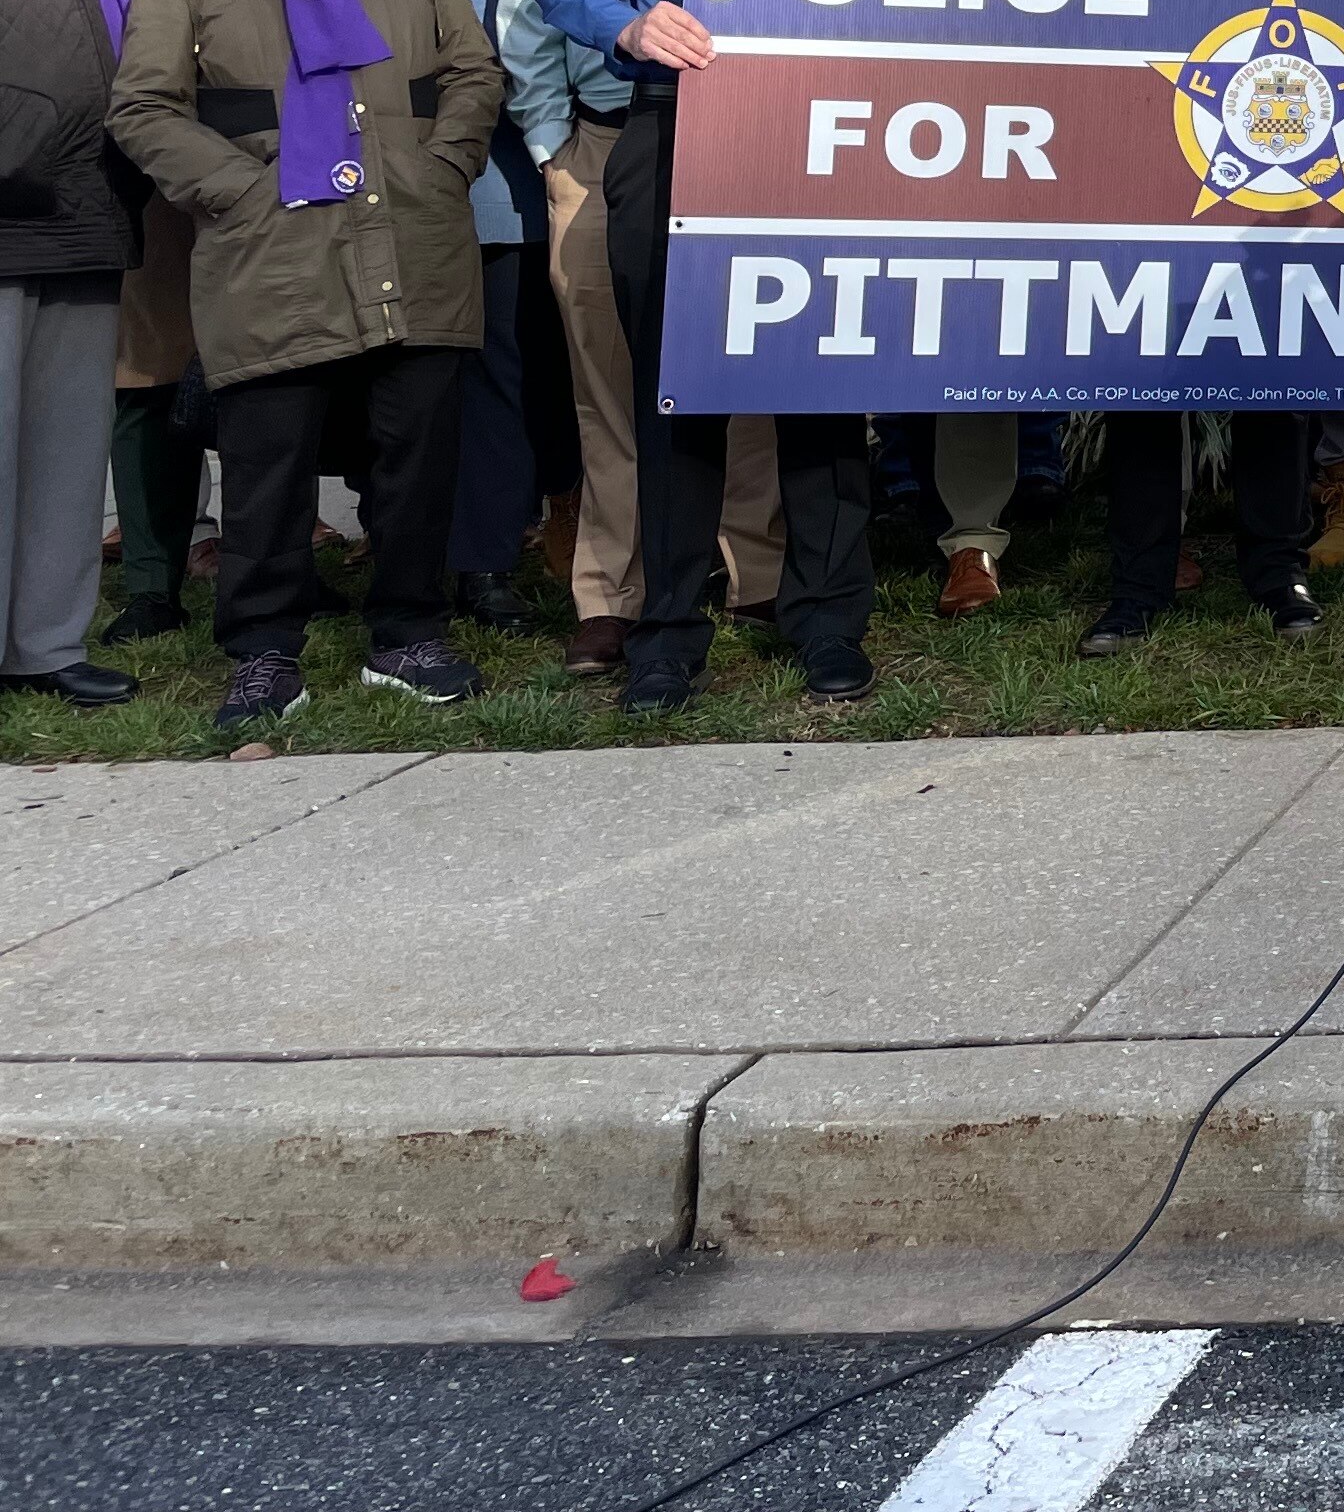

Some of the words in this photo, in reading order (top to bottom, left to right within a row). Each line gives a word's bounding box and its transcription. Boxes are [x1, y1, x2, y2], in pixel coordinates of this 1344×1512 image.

[806, 99, 1057, 181] FOR
[944, 387, 977, 400] Paid
[981, 387, 1002, 400] for
[1007, 387, 1026, 402] by
[1030, 387, 1062, 400] A.A.
[1066, 387, 1091, 400] Co.
[1095, 388, 1128, 400] FOP
[1132, 387, 1180, 402] Lodge
[1184, 387, 1203, 400] 70
[1207, 387, 1243, 402] PAC,
[1247, 387, 1283, 400] John
[1286, 387, 1331, 402] Poole,
